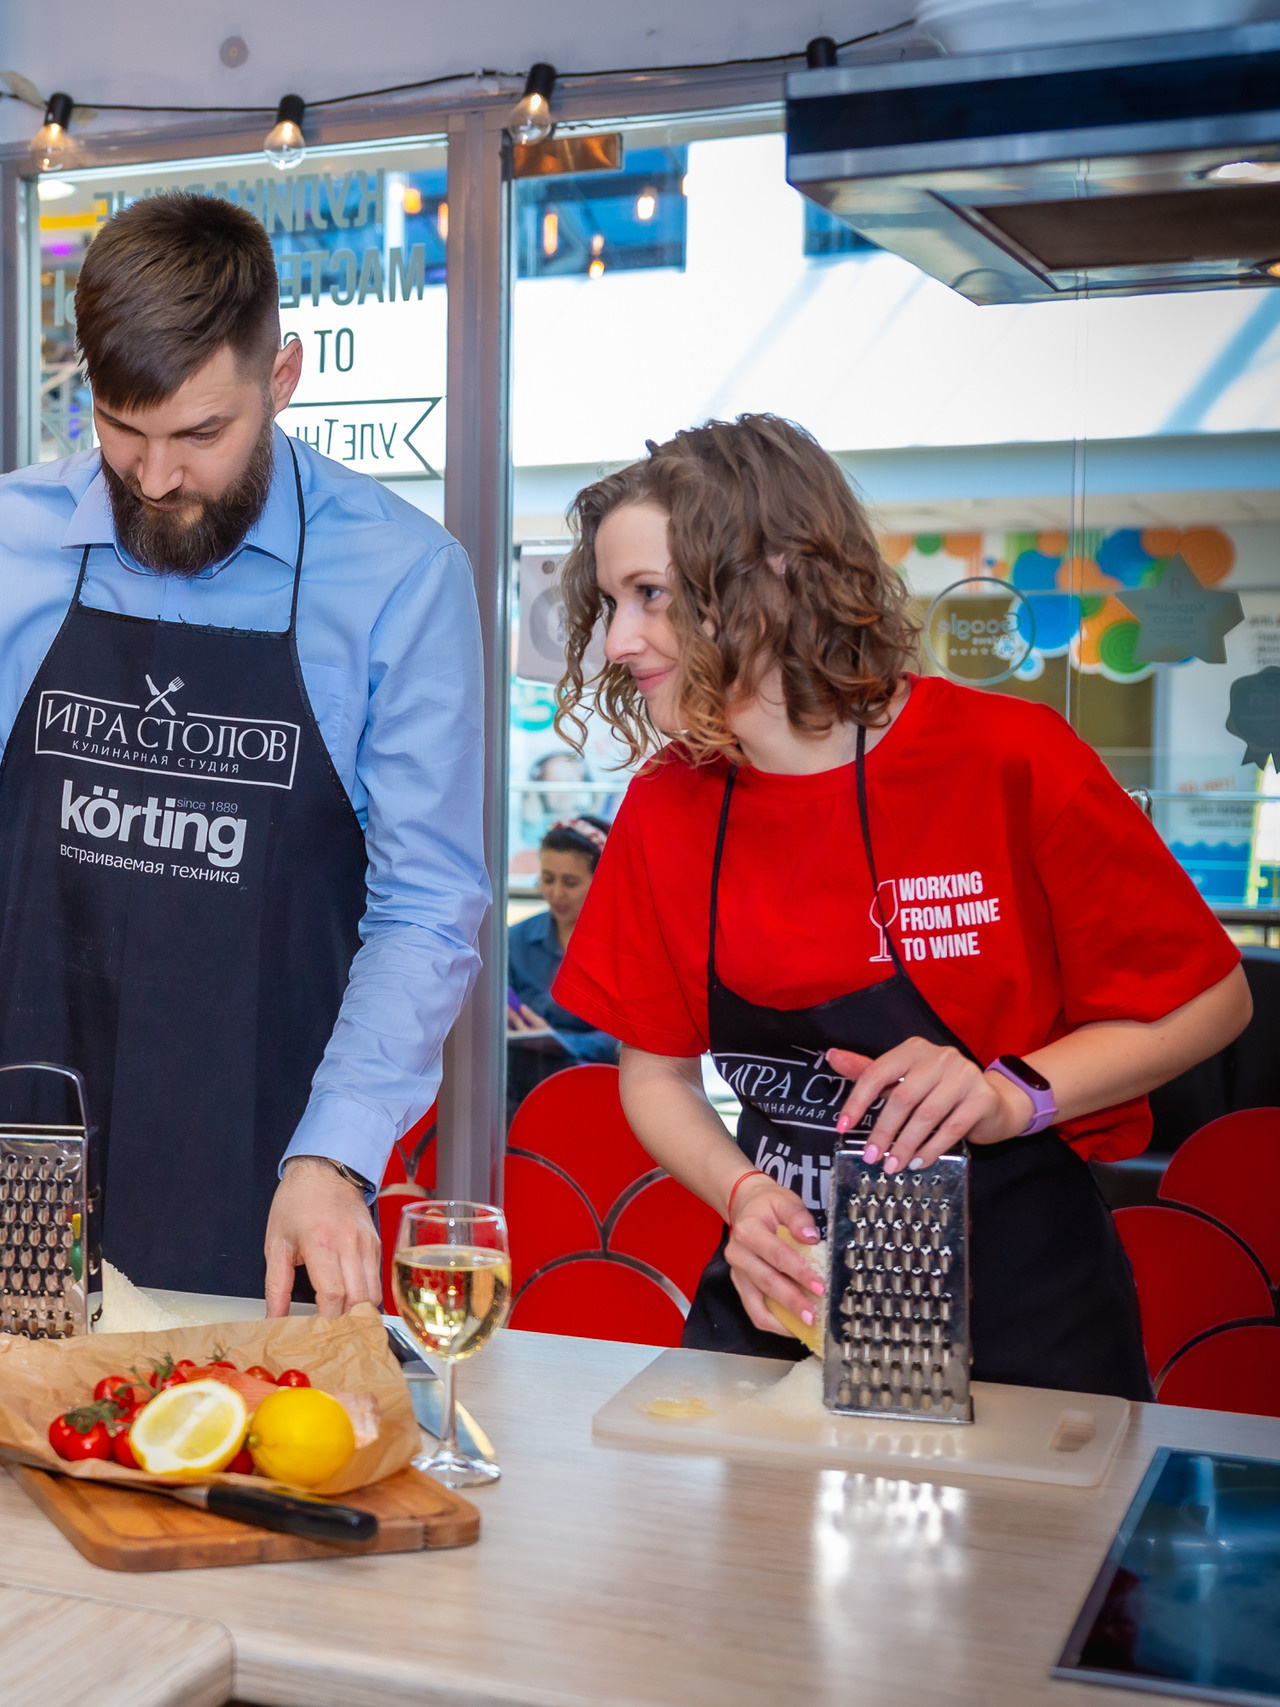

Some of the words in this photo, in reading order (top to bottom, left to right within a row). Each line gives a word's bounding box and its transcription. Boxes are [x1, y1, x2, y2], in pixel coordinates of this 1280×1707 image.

[44, 699, 128, 745] ИГРА
[137, 716, 287, 762] СТОЛОВ
[72, 740, 169, 766] КУЛИНАРНАЯ
[177, 757, 239, 774] СТУДИЯ
[60, 779, 247, 868] körting
[176, 797, 207, 811] since
[210, 800, 238, 814] 1889
[60, 843, 164, 875] встраиваемая
[170, 863, 240, 884] техника
[899, 870, 983, 902] WORKING
[900, 904, 953, 932] FROM
[956, 897, 1000, 926] NINE
[901, 936, 926, 962] TO
[928, 931, 980, 960] WINE
[720, 1062, 792, 1099] ИГРА
[754, 1135, 832, 1210] körti
